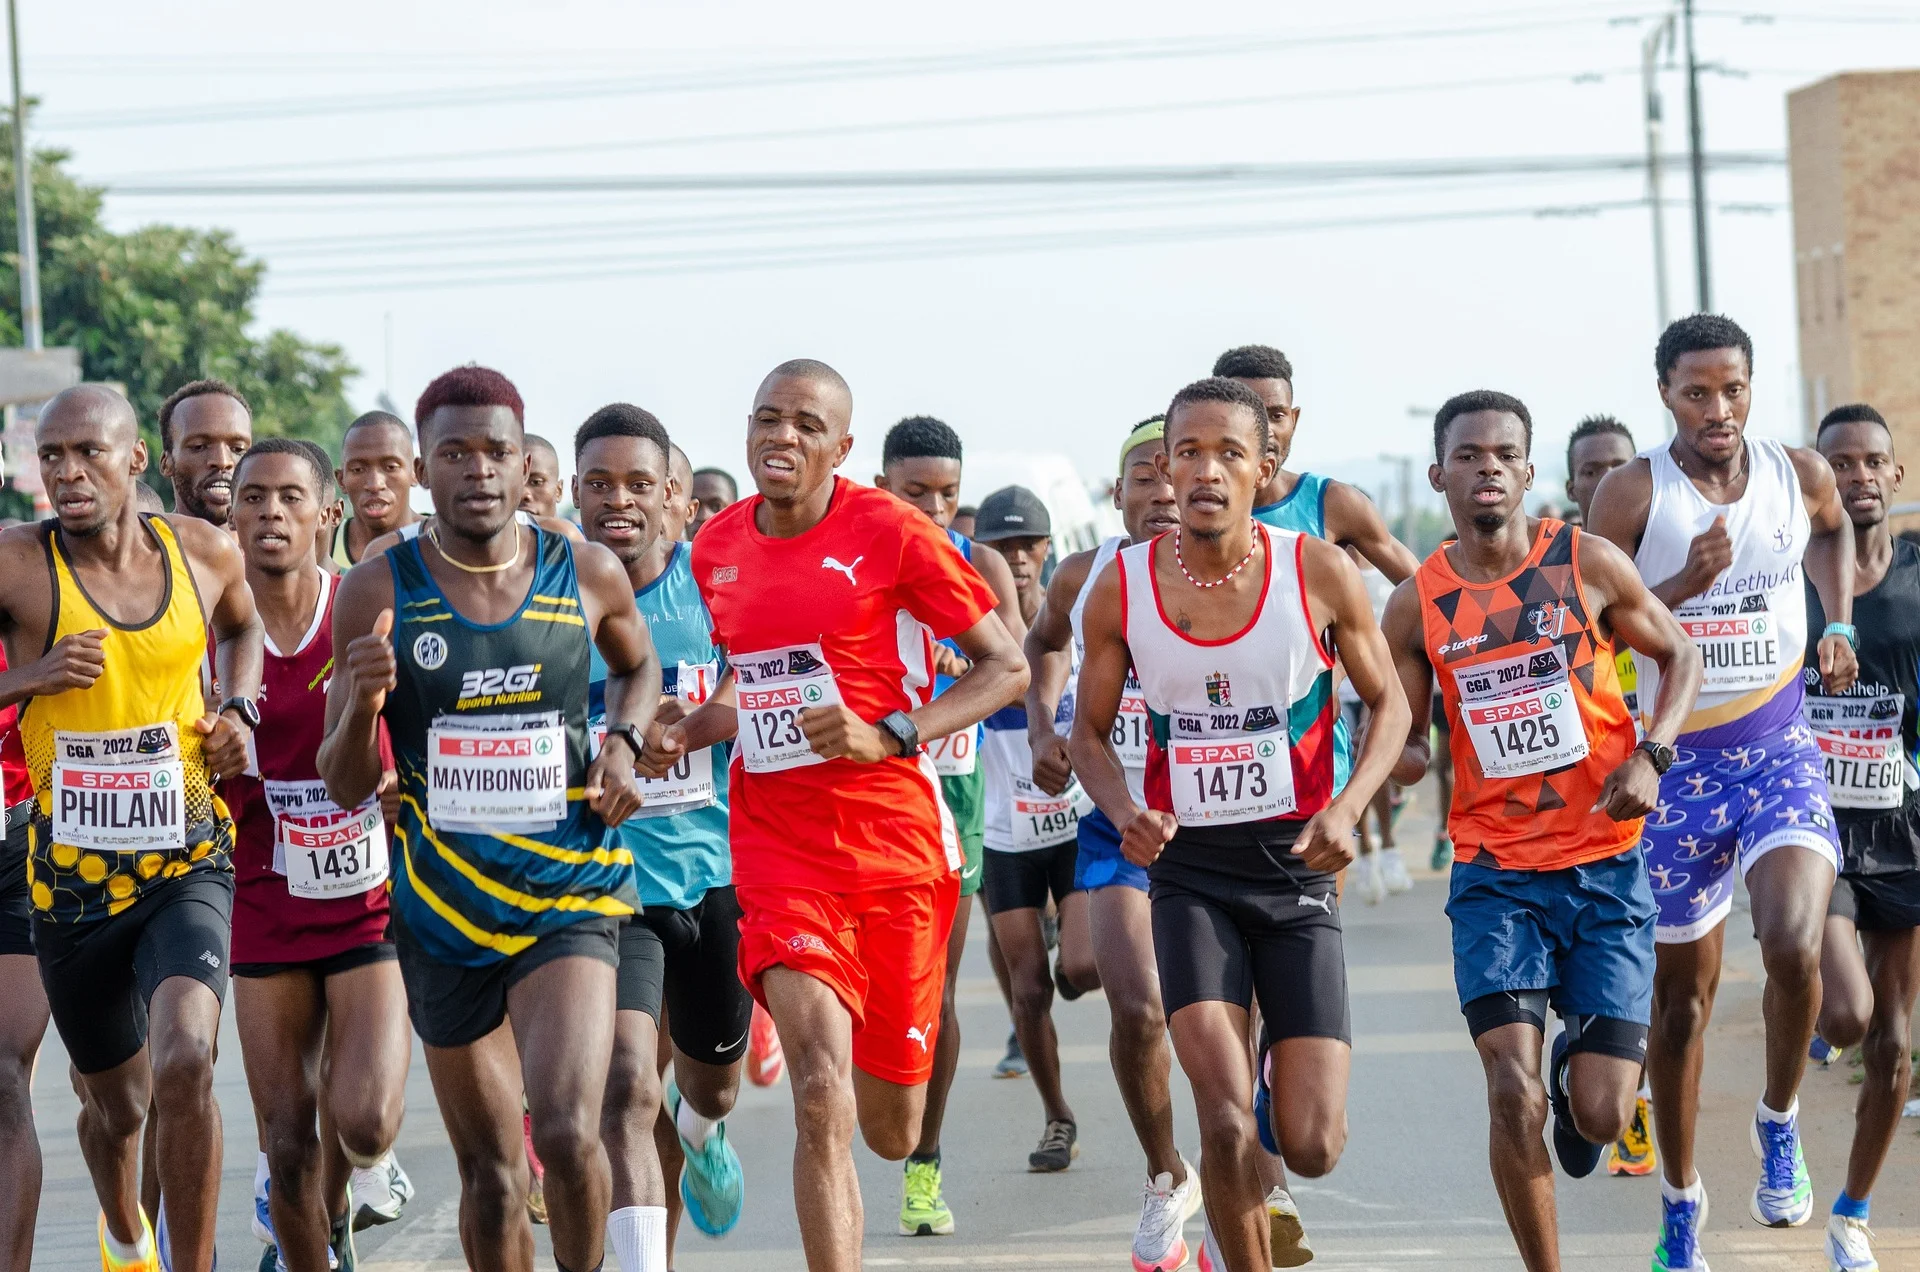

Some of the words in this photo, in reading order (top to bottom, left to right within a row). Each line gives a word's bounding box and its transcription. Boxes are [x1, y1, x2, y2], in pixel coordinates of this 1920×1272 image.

[1742, 595, 1765, 610] ASA
[1692, 621, 1748, 636] SPAR
[1452, 634, 1488, 651] lotto
[791, 652, 814, 666] ASA
[1531, 654, 1557, 669] ASA
[1697, 640, 1776, 668] HULELE
[758, 659, 785, 678] 2022
[1497, 663, 1526, 684] 2022
[460, 664, 541, 699] 32Gi
[687, 669, 707, 705] J
[1466, 678, 1492, 693] CGA
[456, 696, 493, 711] Sports
[495, 691, 542, 705] Nutrition
[746, 690, 800, 708] SPAR
[1247, 708, 1275, 723] ASA
[1484, 698, 1541, 722] SPAR
[1842, 705, 1867, 718] 2022
[1178, 718, 1202, 733] CGA
[1211, 714, 1239, 730] 2022
[140, 729, 168, 745] ASA
[1491, 713, 1560, 758] 1425
[66, 744, 95, 758] CGA
[103, 738, 133, 755] 2022
[460, 739, 530, 756] SPAR
[1190, 745, 1252, 762] SPAR
[1829, 741, 1885, 758] SPAR
[82, 773, 149, 788] SPAR
[433, 765, 562, 792] MAYIBONGWE
[1824, 757, 1902, 788] ATLEGO
[1194, 762, 1268, 803] 1473
[305, 787, 330, 803] 202
[61, 789, 176, 828] PHILANI
[1026, 800, 1068, 813] SPAR
[1030, 807, 1078, 836] 1494
[168, 832, 178, 841] 39
[302, 824, 362, 847] SPAR
[307, 836, 371, 880] 1437
